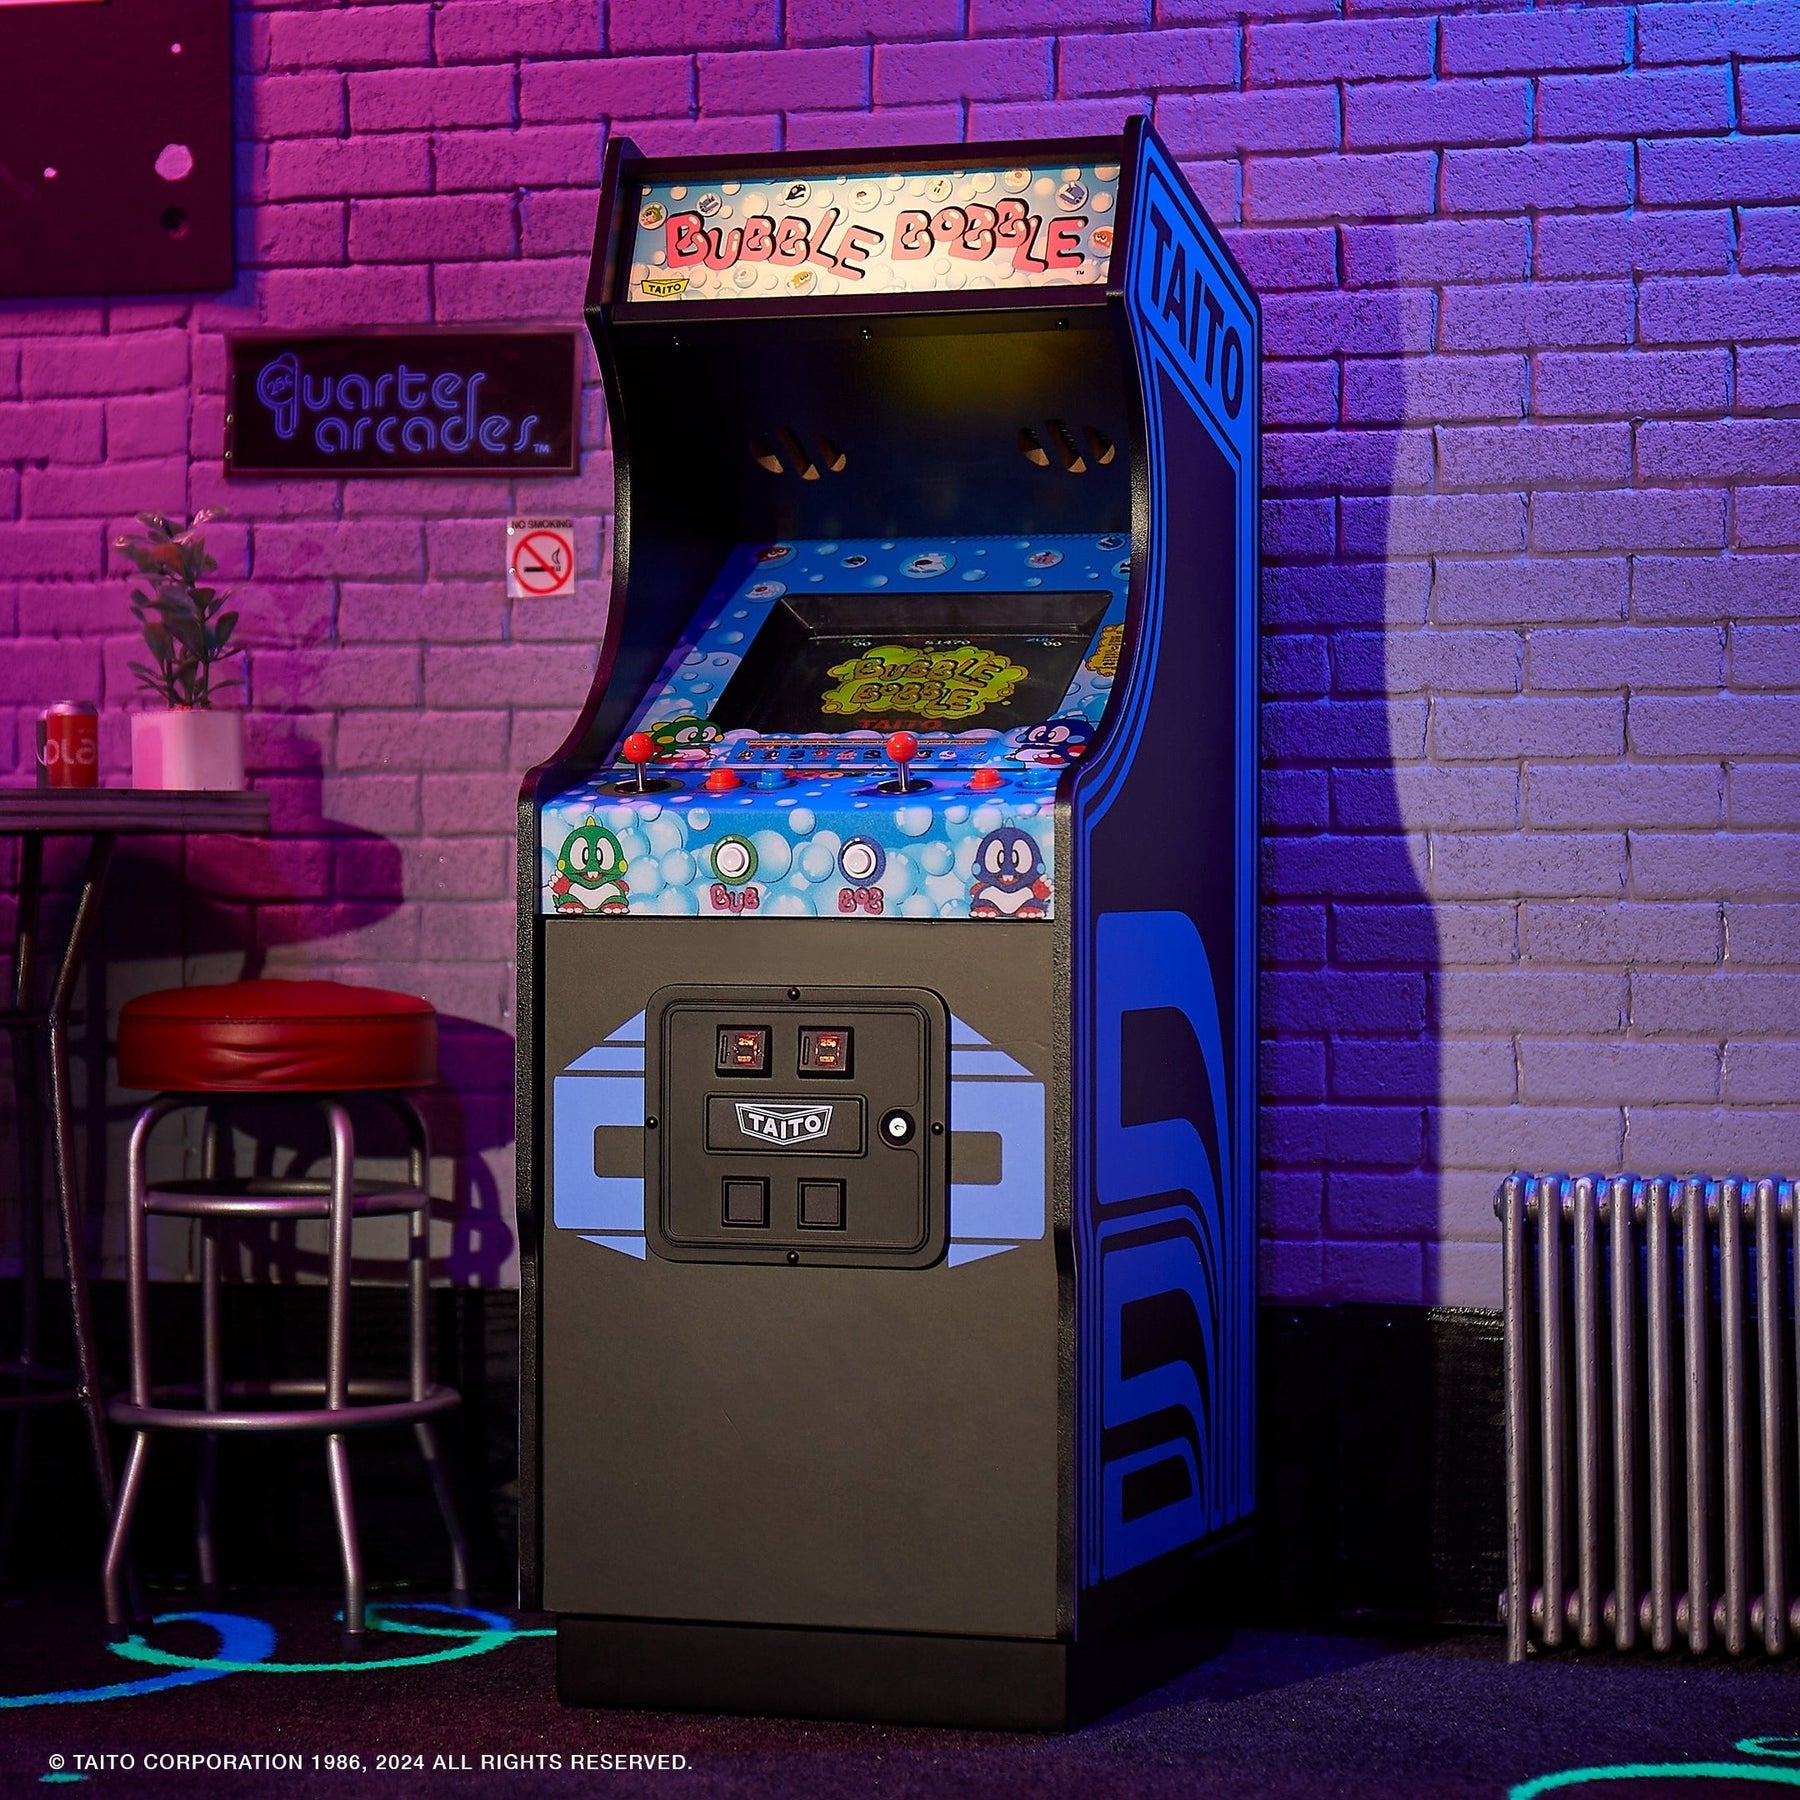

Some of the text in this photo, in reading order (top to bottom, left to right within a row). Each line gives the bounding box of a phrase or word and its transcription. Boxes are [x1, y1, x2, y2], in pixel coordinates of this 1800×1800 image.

[666, 208, 884, 281] BUBBLE
[891, 198, 1089, 273] BOBBLE
[648, 283, 682, 294] TAITO
[1150, 200, 1244, 421] TAITO
[315, 415, 538, 452] arcades
[511, 519, 574, 529] NO SMOKING
[855, 657, 1001, 688] BUBBLE
[851, 680, 979, 711] BOBBLE
[858, 719, 943, 731] TAITO
[709, 883, 760, 913] BUB
[838, 887, 884, 916] BOB
[748, 1113, 821, 1139] TAITO
